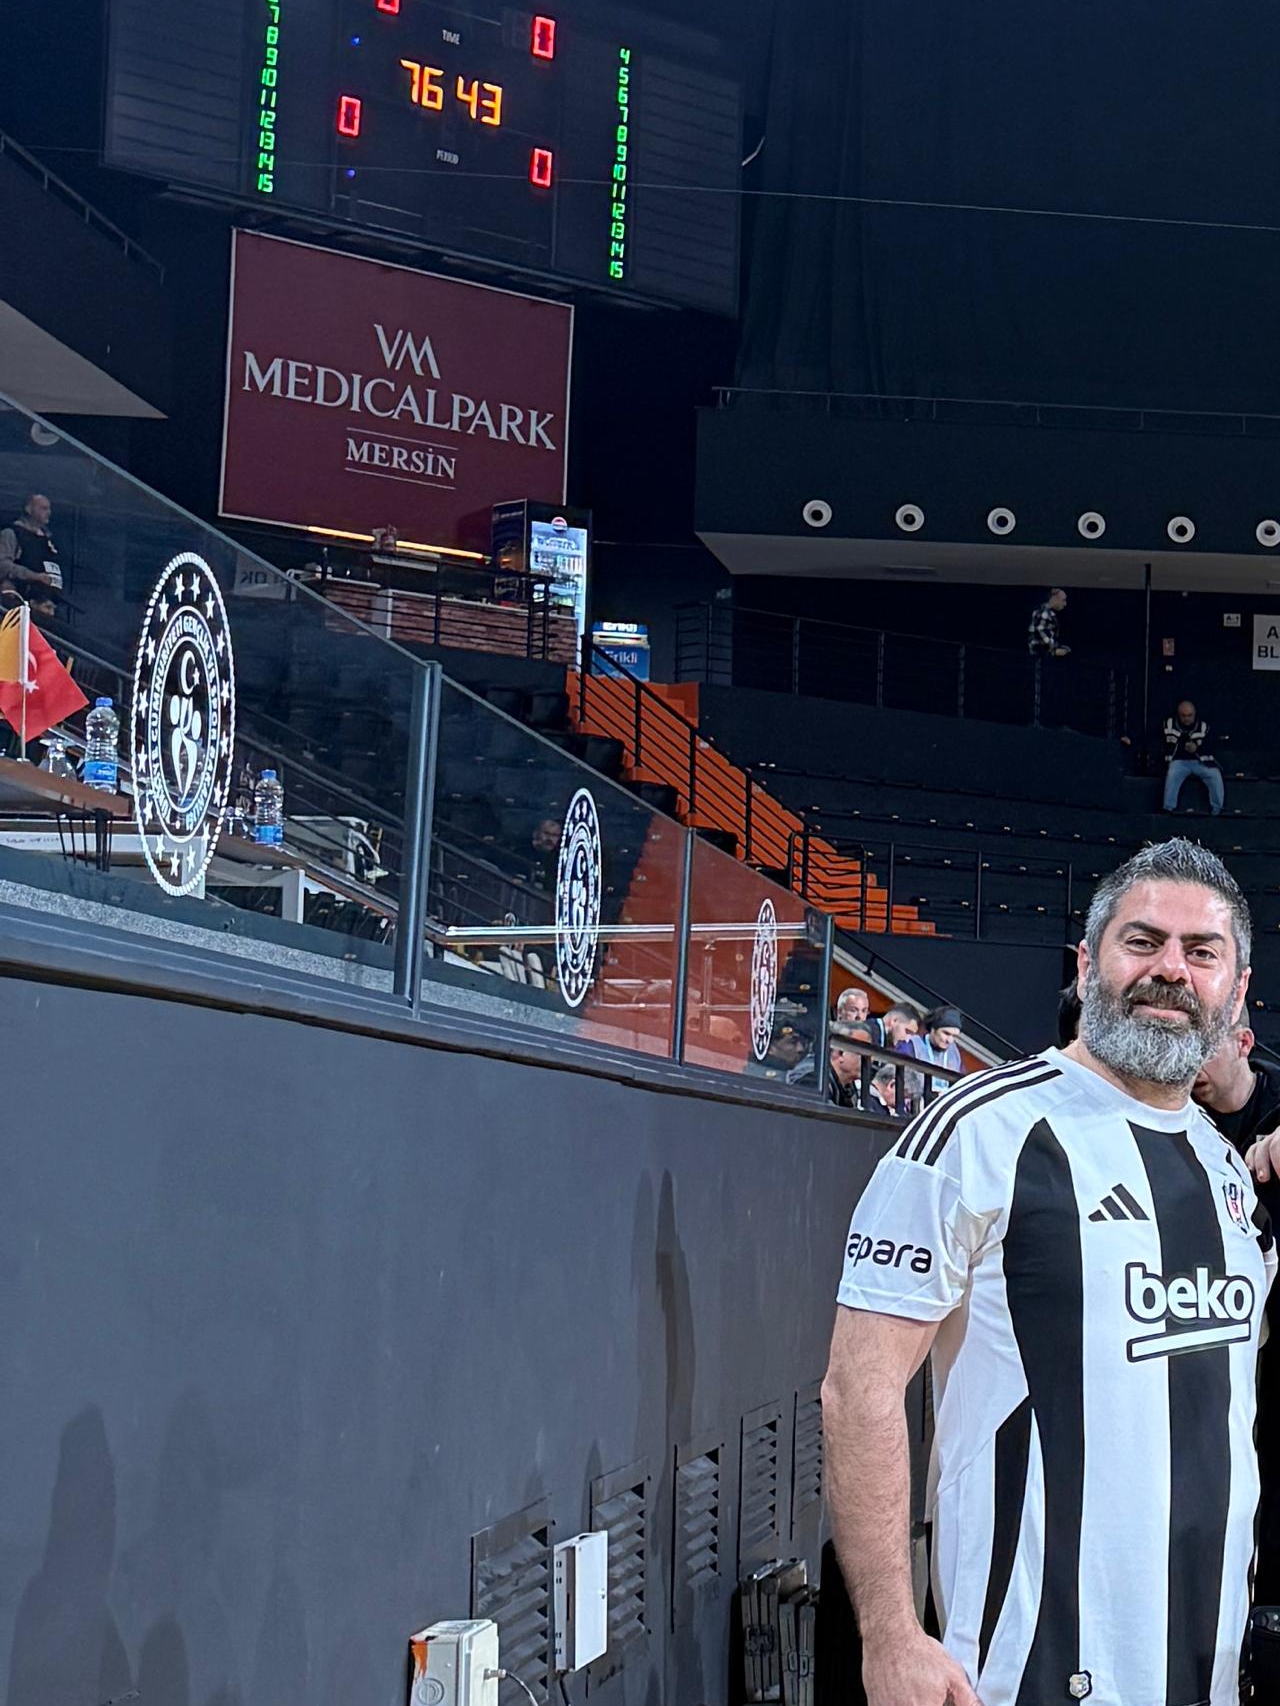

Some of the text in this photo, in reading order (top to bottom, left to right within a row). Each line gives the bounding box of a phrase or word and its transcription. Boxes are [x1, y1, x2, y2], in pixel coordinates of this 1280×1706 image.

[269, 5, 280, 24] 7
[266, 26, 279, 45] 8
[532, 16, 556, 59] 0
[266, 47, 278, 66] 9
[620, 48, 630, 64] 4
[262, 68, 277, 87] 10
[619, 67, 629, 84] 5
[260, 89, 276, 108] 11
[400, 59, 503, 126] 76 43
[618, 87, 628, 104] 6
[260, 110, 276, 129] 12
[338, 95, 361, 137] 0
[619, 105, 628, 123] 7
[259, 131, 275, 150] 13
[617, 125, 627, 142] 8
[258, 153, 274, 171] 14
[617, 144, 627, 161] 9
[530, 148, 553, 187] 0
[613, 163, 626, 181] 10
[257, 173, 274, 193] 15
[612, 183, 626, 200] 11
[612, 202, 625, 220] 12
[611, 222, 625, 239] 13
[610, 241, 624, 258] 14
[610, 261, 623, 278] 15
[373, 324, 441, 379] VM
[242, 350, 557, 451] MEDICALPARK
[346, 438, 457, 479] MERSİN
[1126, 1263, 1254, 1322] beko
